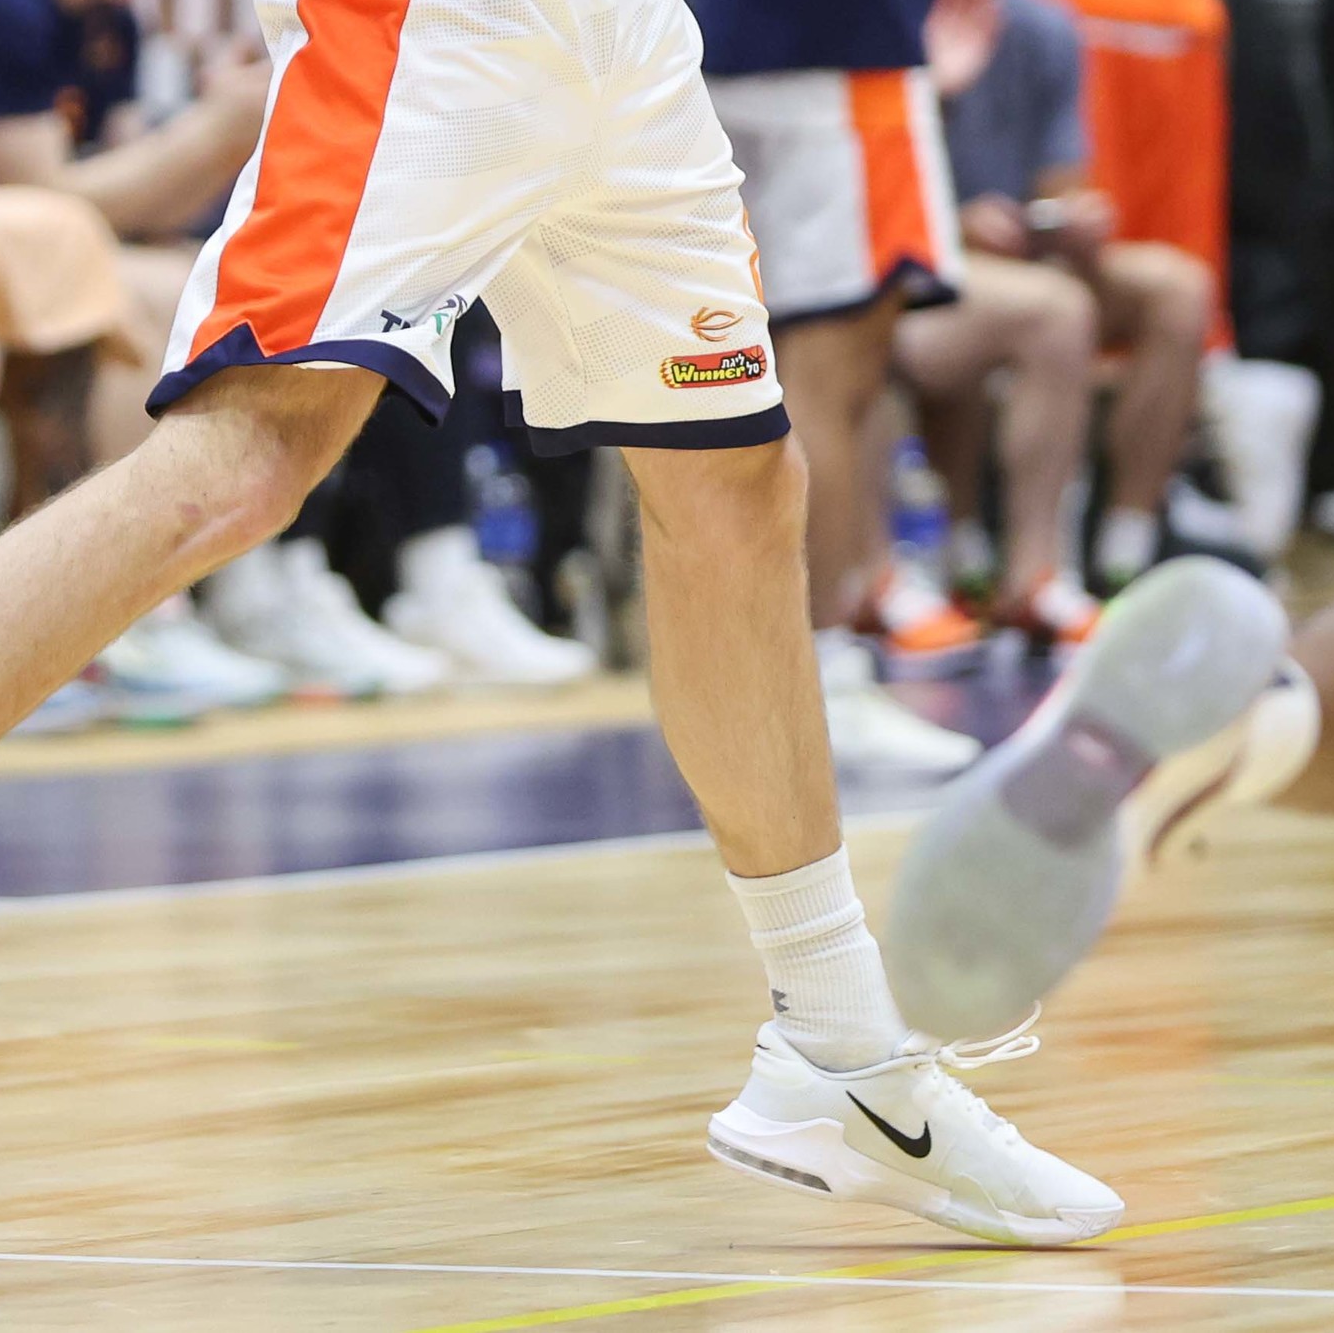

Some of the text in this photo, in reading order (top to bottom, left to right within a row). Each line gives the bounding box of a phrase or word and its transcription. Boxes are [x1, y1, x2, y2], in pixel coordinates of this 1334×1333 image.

[721, 352, 746, 369] ליגת
[746, 360, 760, 375] סל
[671, 364, 746, 383] Winner
